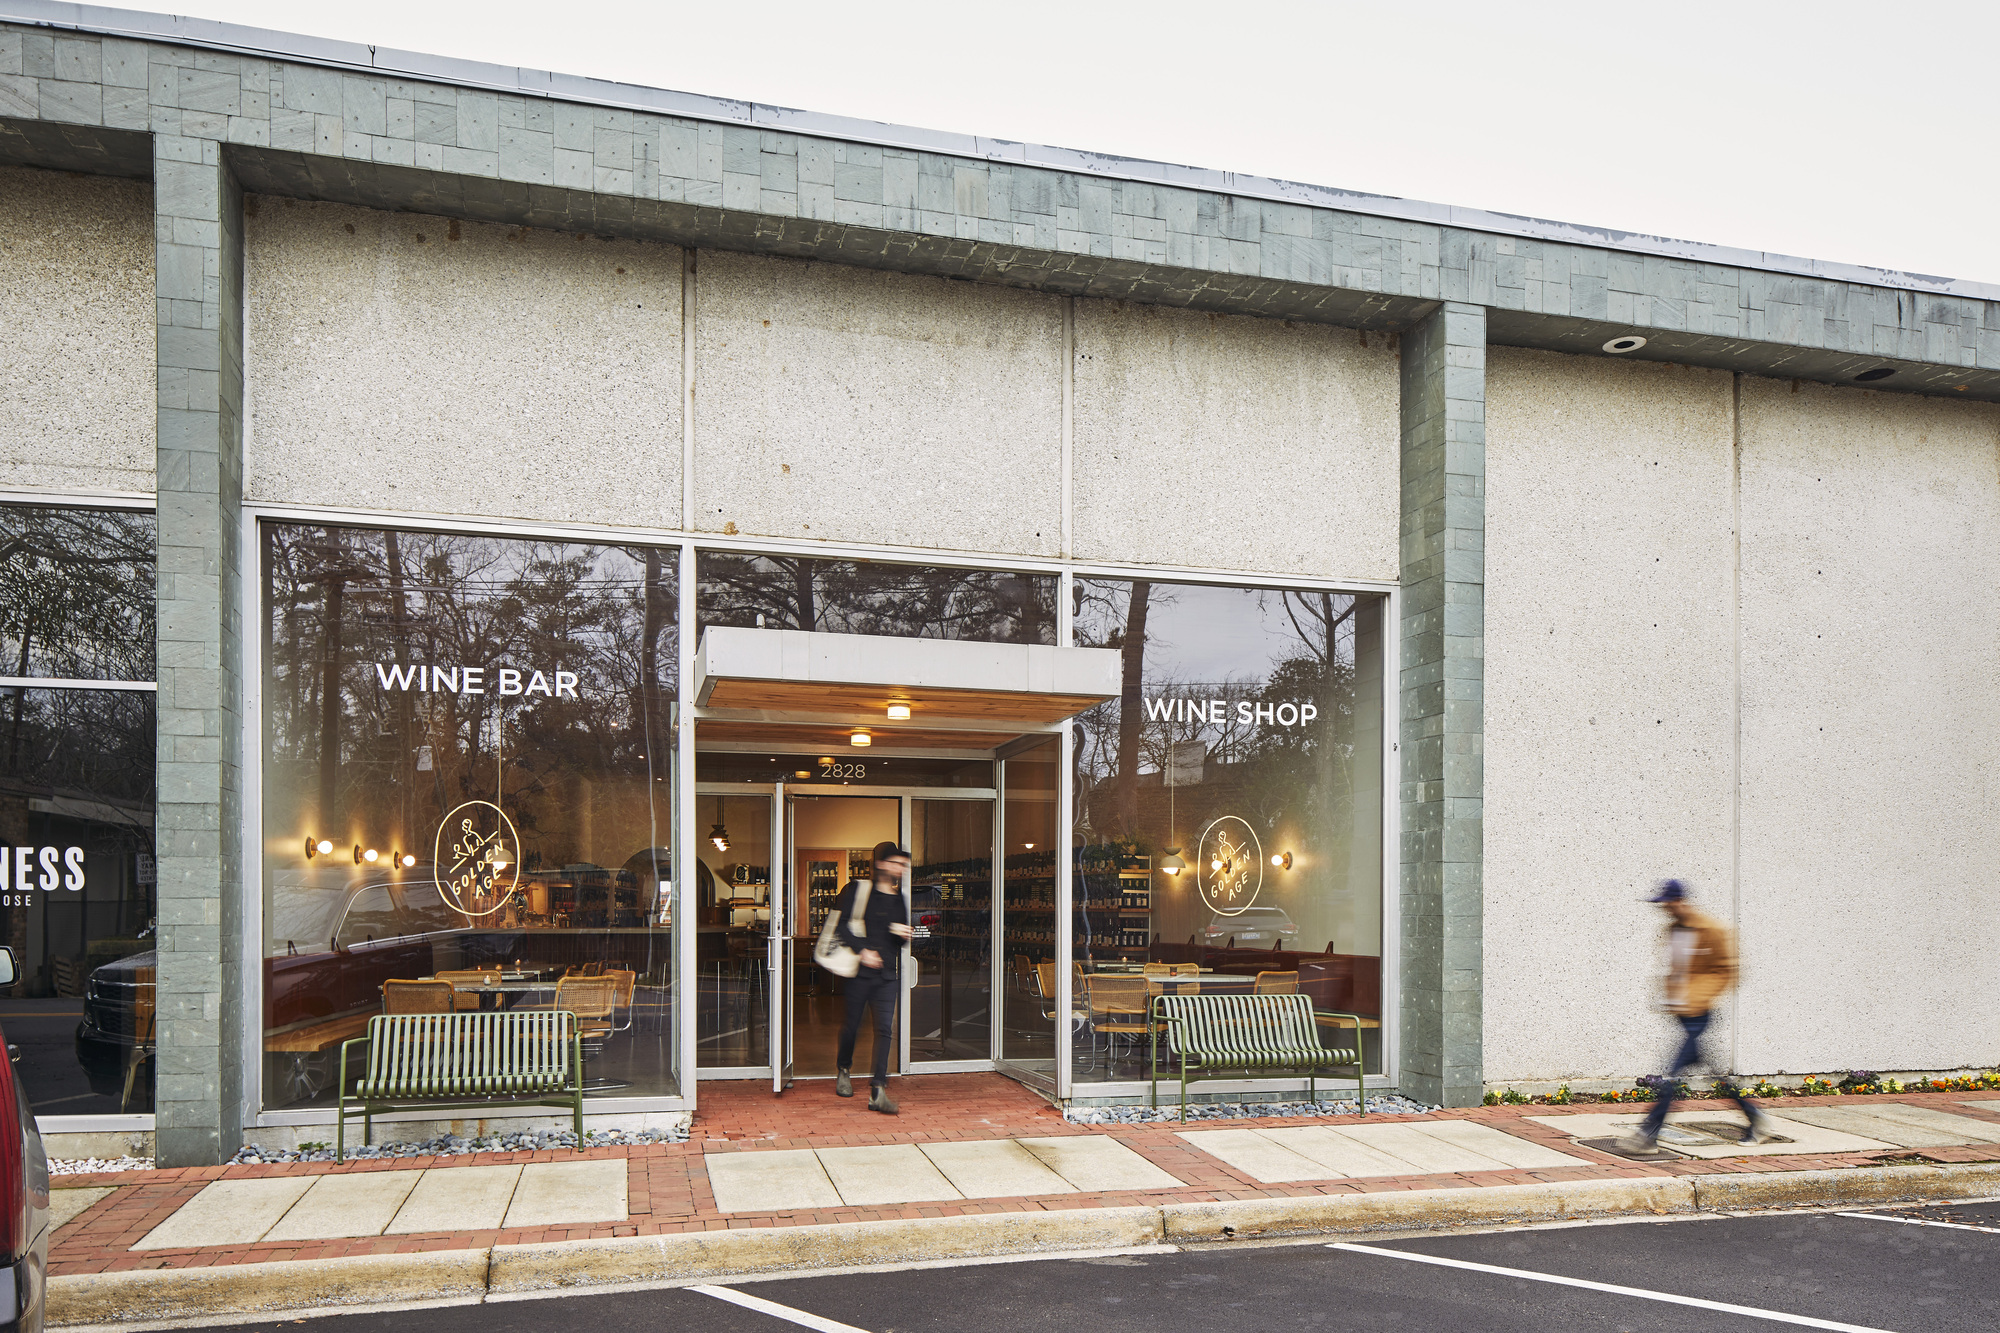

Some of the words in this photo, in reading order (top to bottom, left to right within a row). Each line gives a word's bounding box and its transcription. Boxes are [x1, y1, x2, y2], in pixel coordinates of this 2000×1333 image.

[375, 663, 484, 694] WINE
[499, 668, 579, 698] BAR
[1143, 697, 1227, 724] WINE
[1236, 701, 1318, 727] SHOP
[820, 763, 866, 779] 2828
[452, 839, 504, 896] GOLDEN
[475, 866, 502, 900] AGE
[1211, 849, 1251, 898] GOLDEN
[2, 894, 32, 907] OSE
[1228, 870, 1249, 902] AGE
